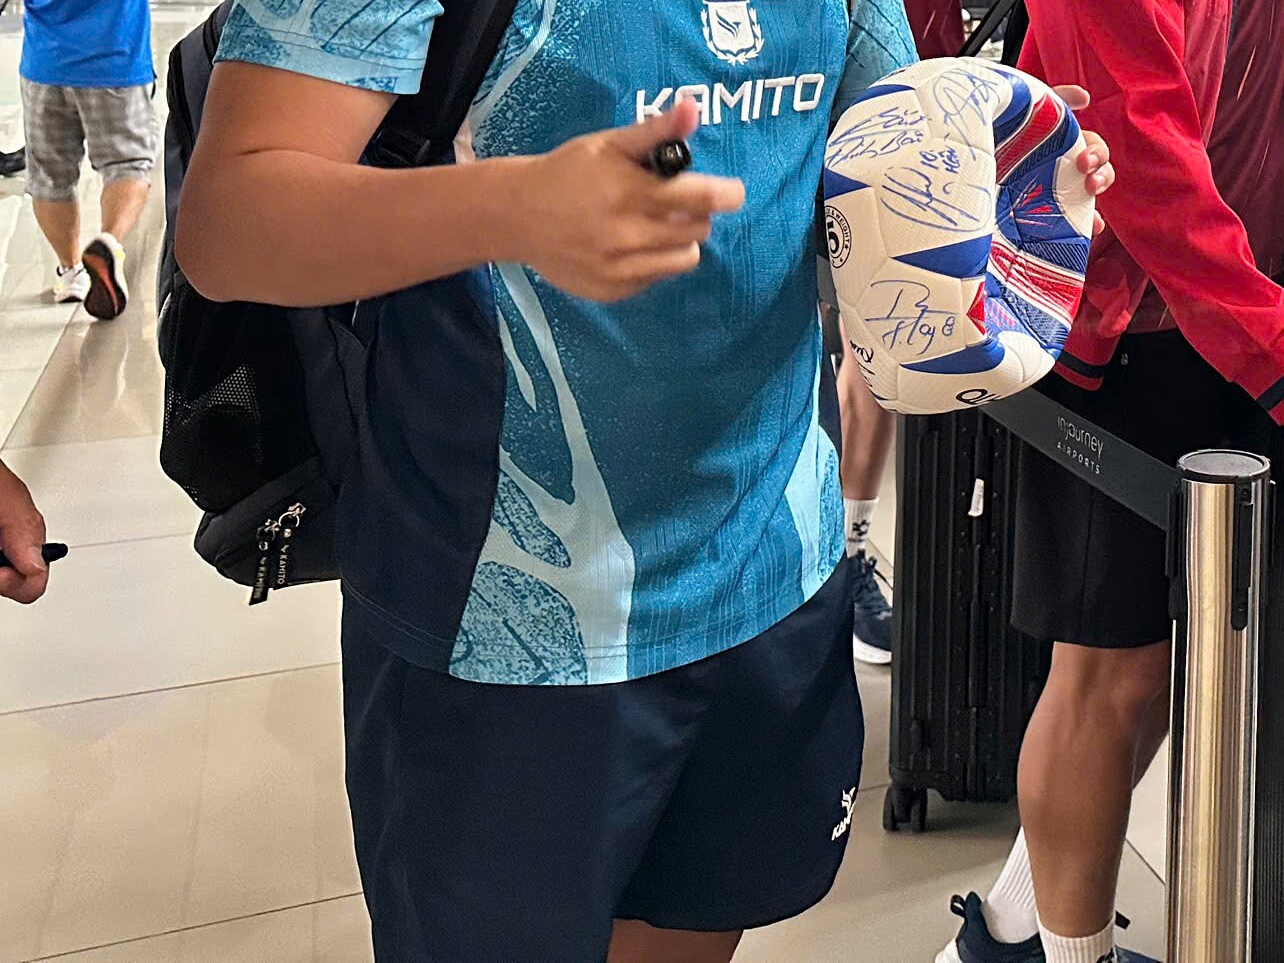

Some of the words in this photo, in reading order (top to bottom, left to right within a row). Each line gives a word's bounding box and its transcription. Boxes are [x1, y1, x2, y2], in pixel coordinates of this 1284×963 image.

[635, 73, 825, 126] KAMITO
[827, 220, 840, 255] 5
[1056, 441, 1101, 475] AIRPORTS
[277, 554, 288, 585] KAMITO
